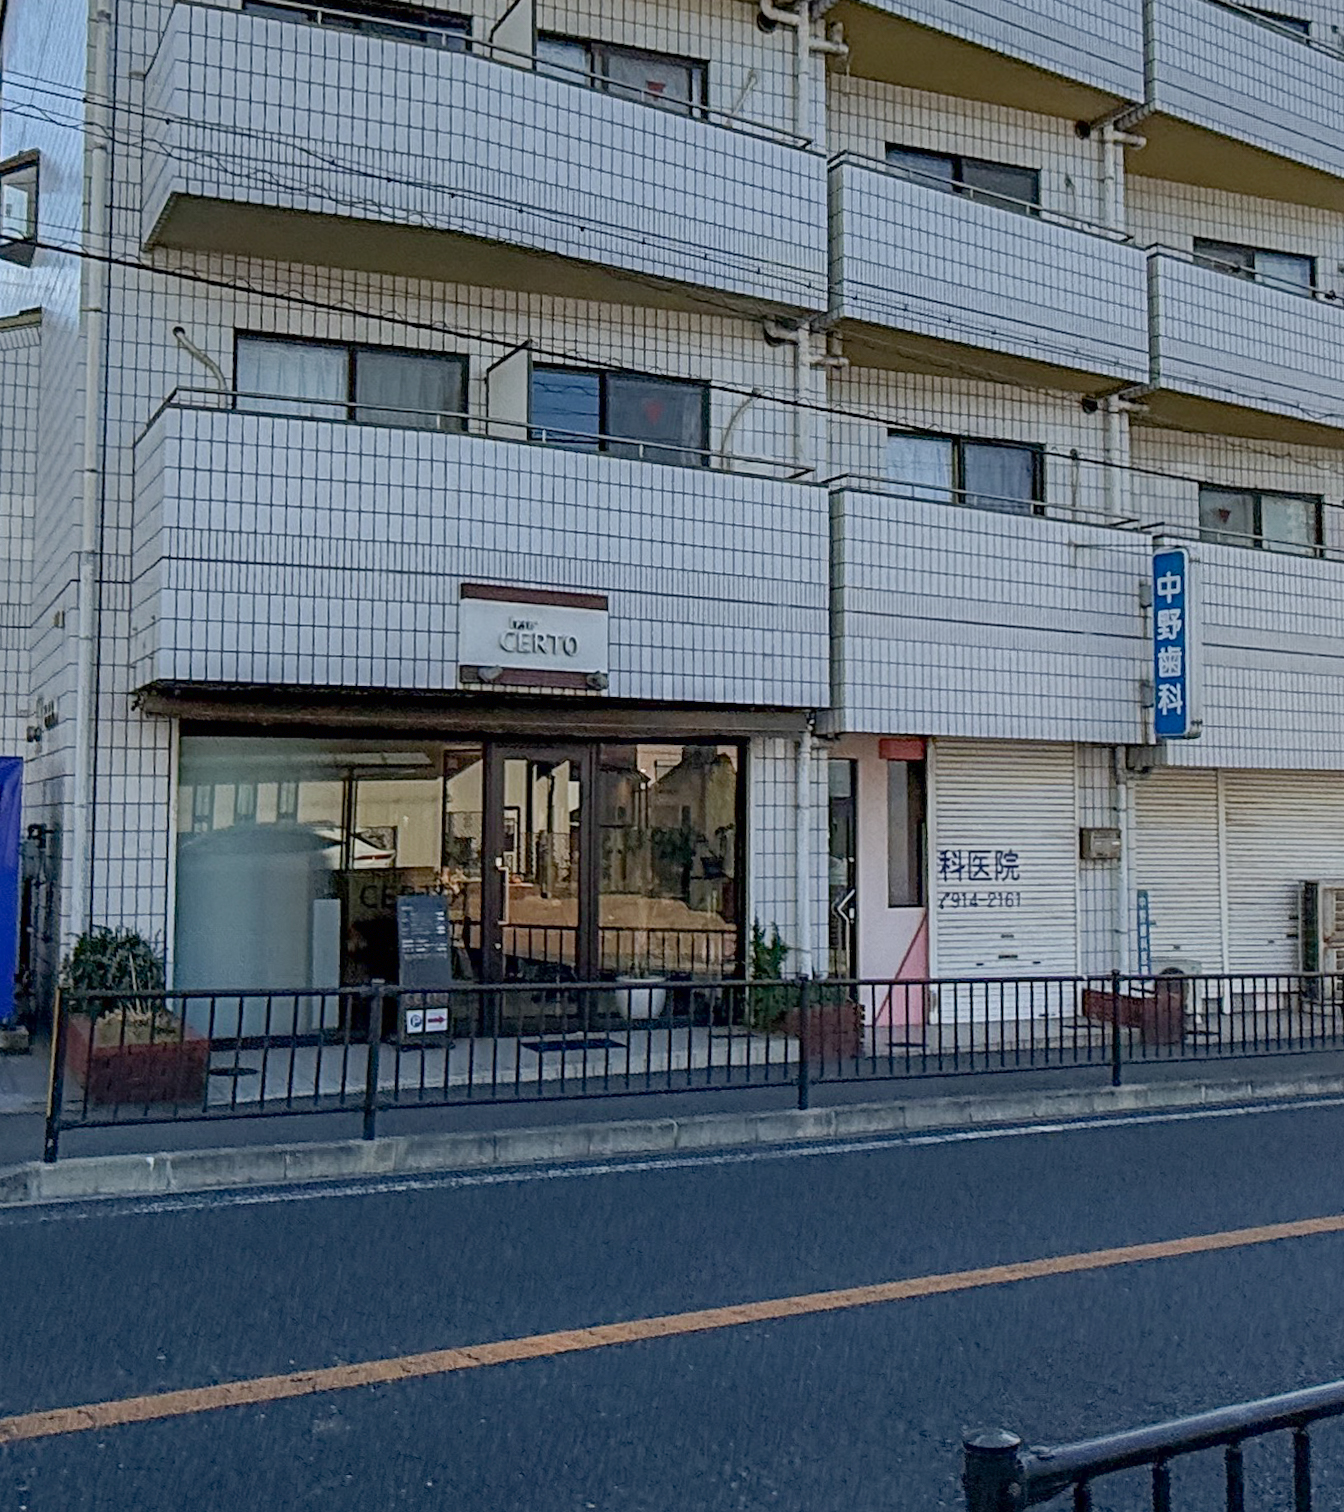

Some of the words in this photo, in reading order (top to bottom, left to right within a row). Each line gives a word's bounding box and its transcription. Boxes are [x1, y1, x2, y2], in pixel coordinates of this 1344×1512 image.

[499, 631, 579, 657] CERTO
[1157, 571, 1183, 715] 中野歯科
[939, 849, 1020, 882] 科医院
